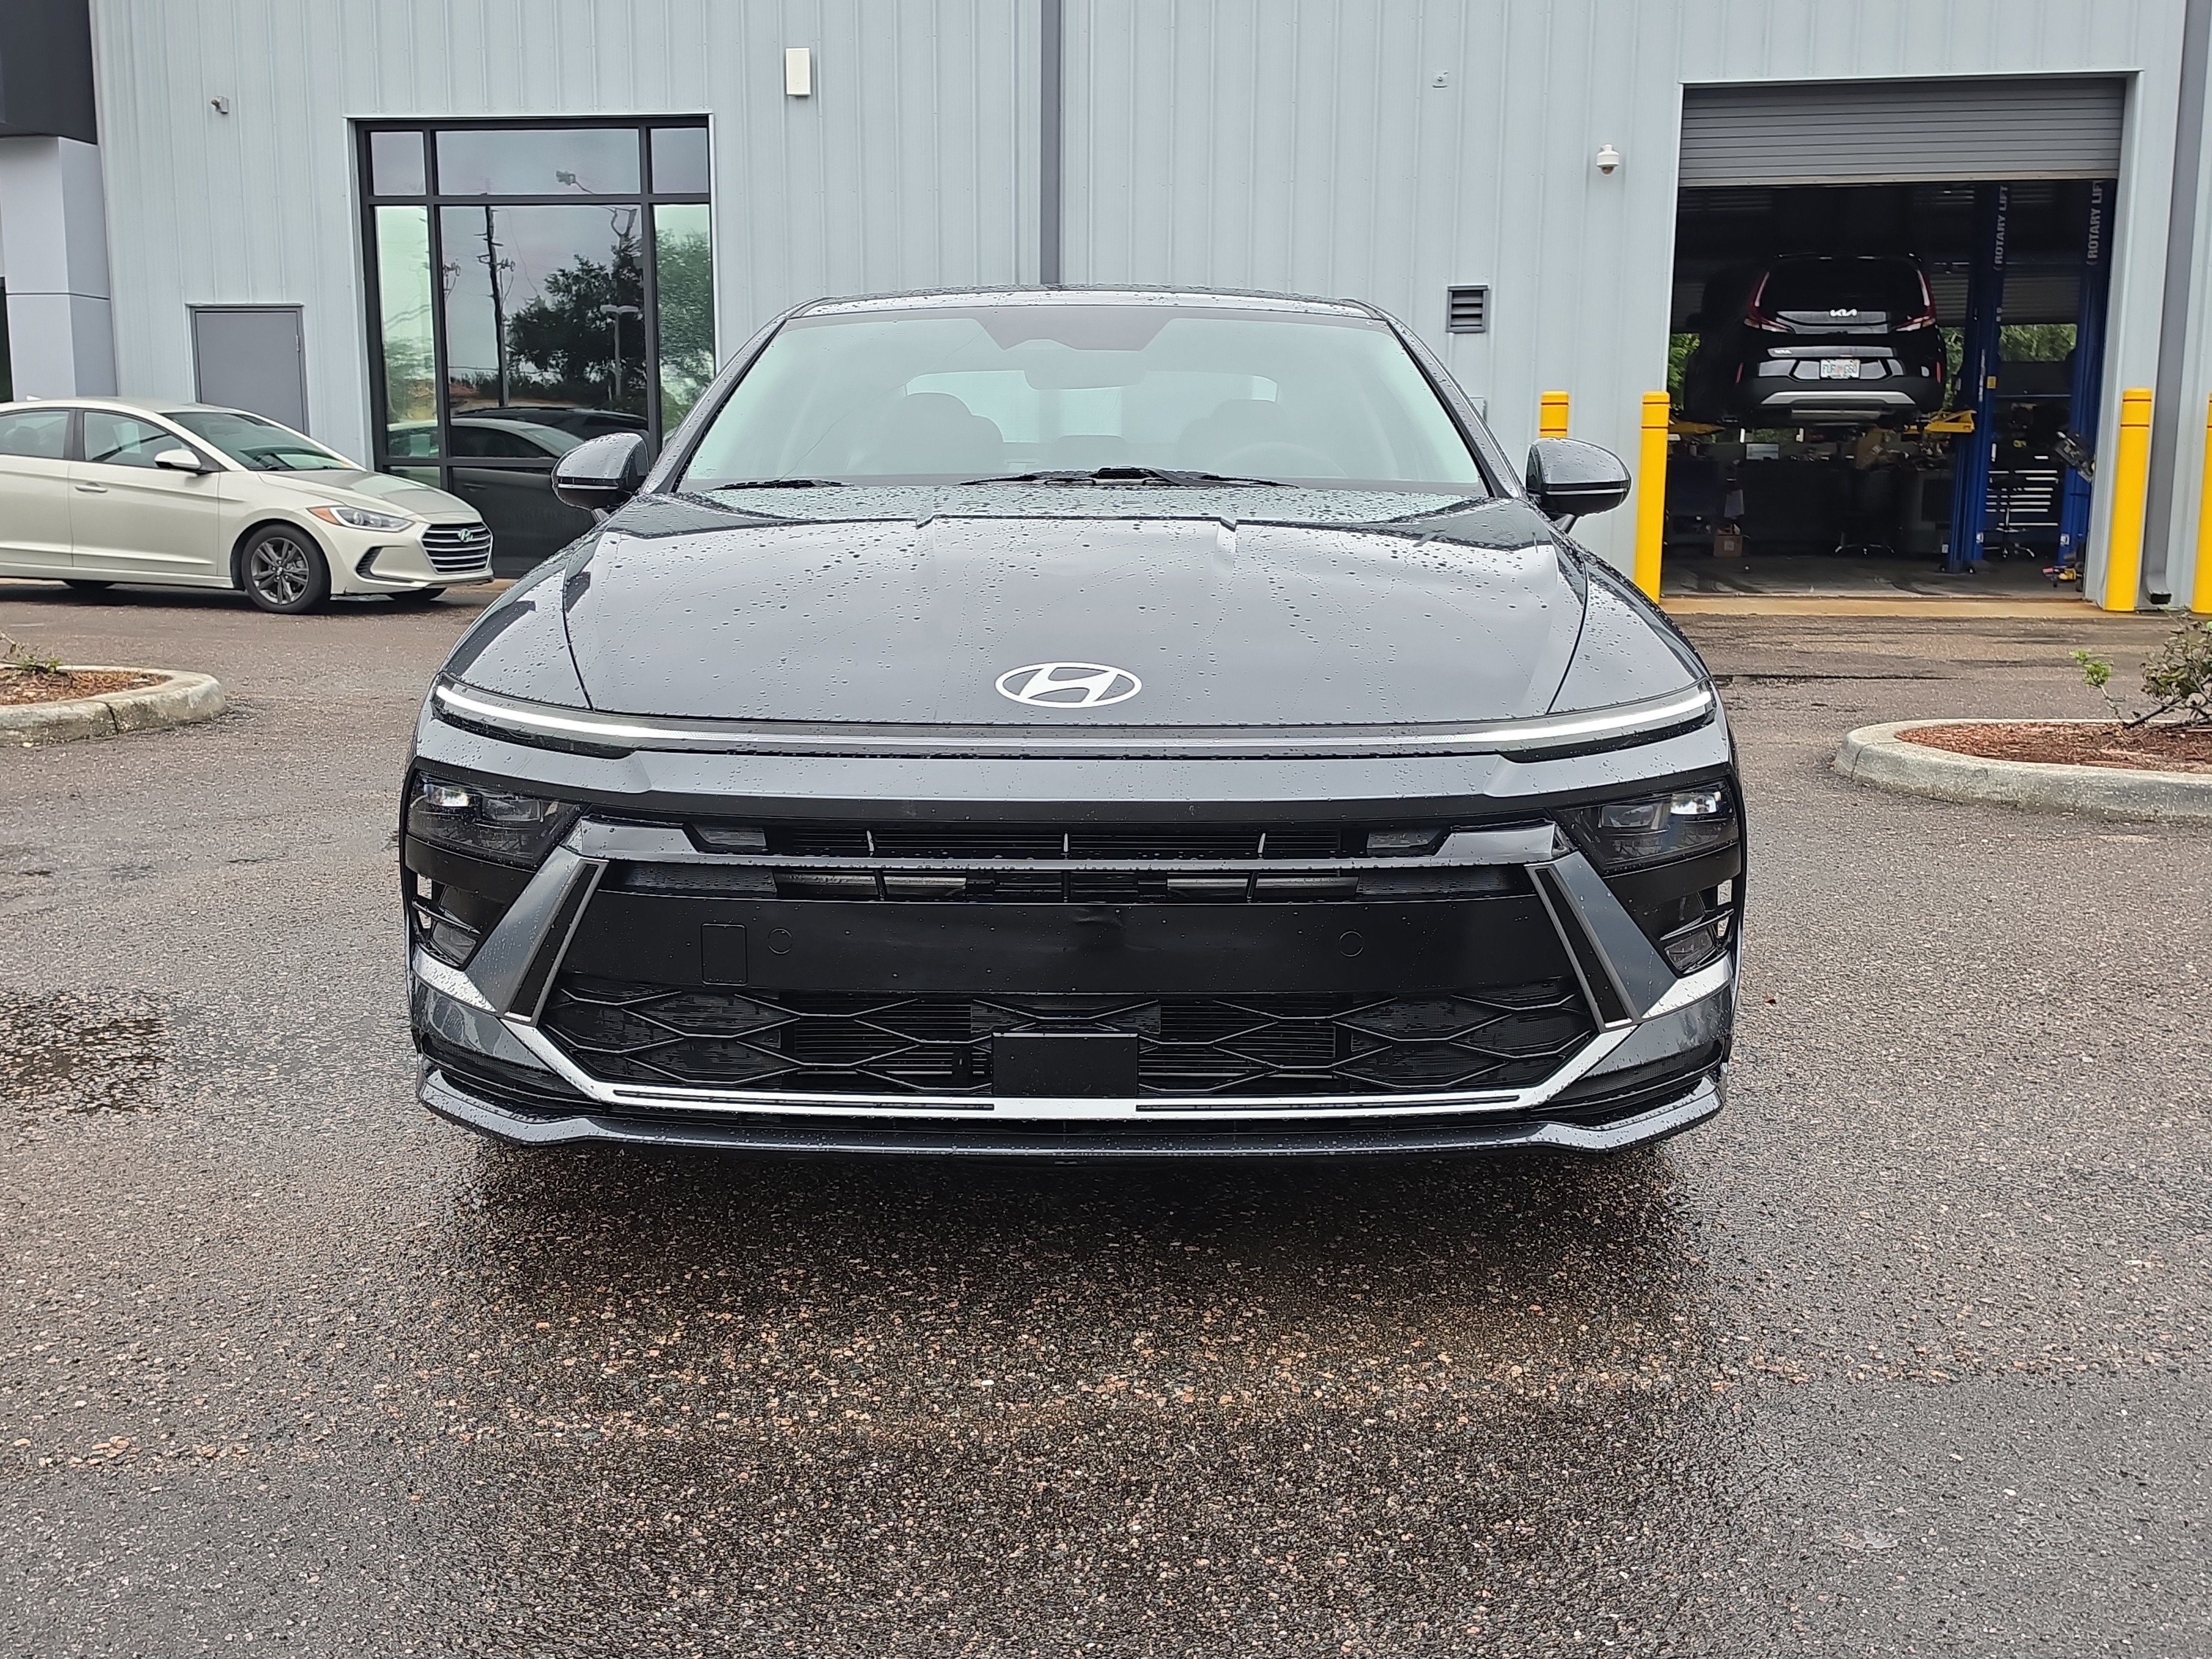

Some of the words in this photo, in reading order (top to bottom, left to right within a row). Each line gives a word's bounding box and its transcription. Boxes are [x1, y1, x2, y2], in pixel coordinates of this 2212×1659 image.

[1998, 185, 2009, 211] LIFT
[1994, 215, 2007, 265] ROTARY
[2087, 207, 2101, 259] ROTARY
